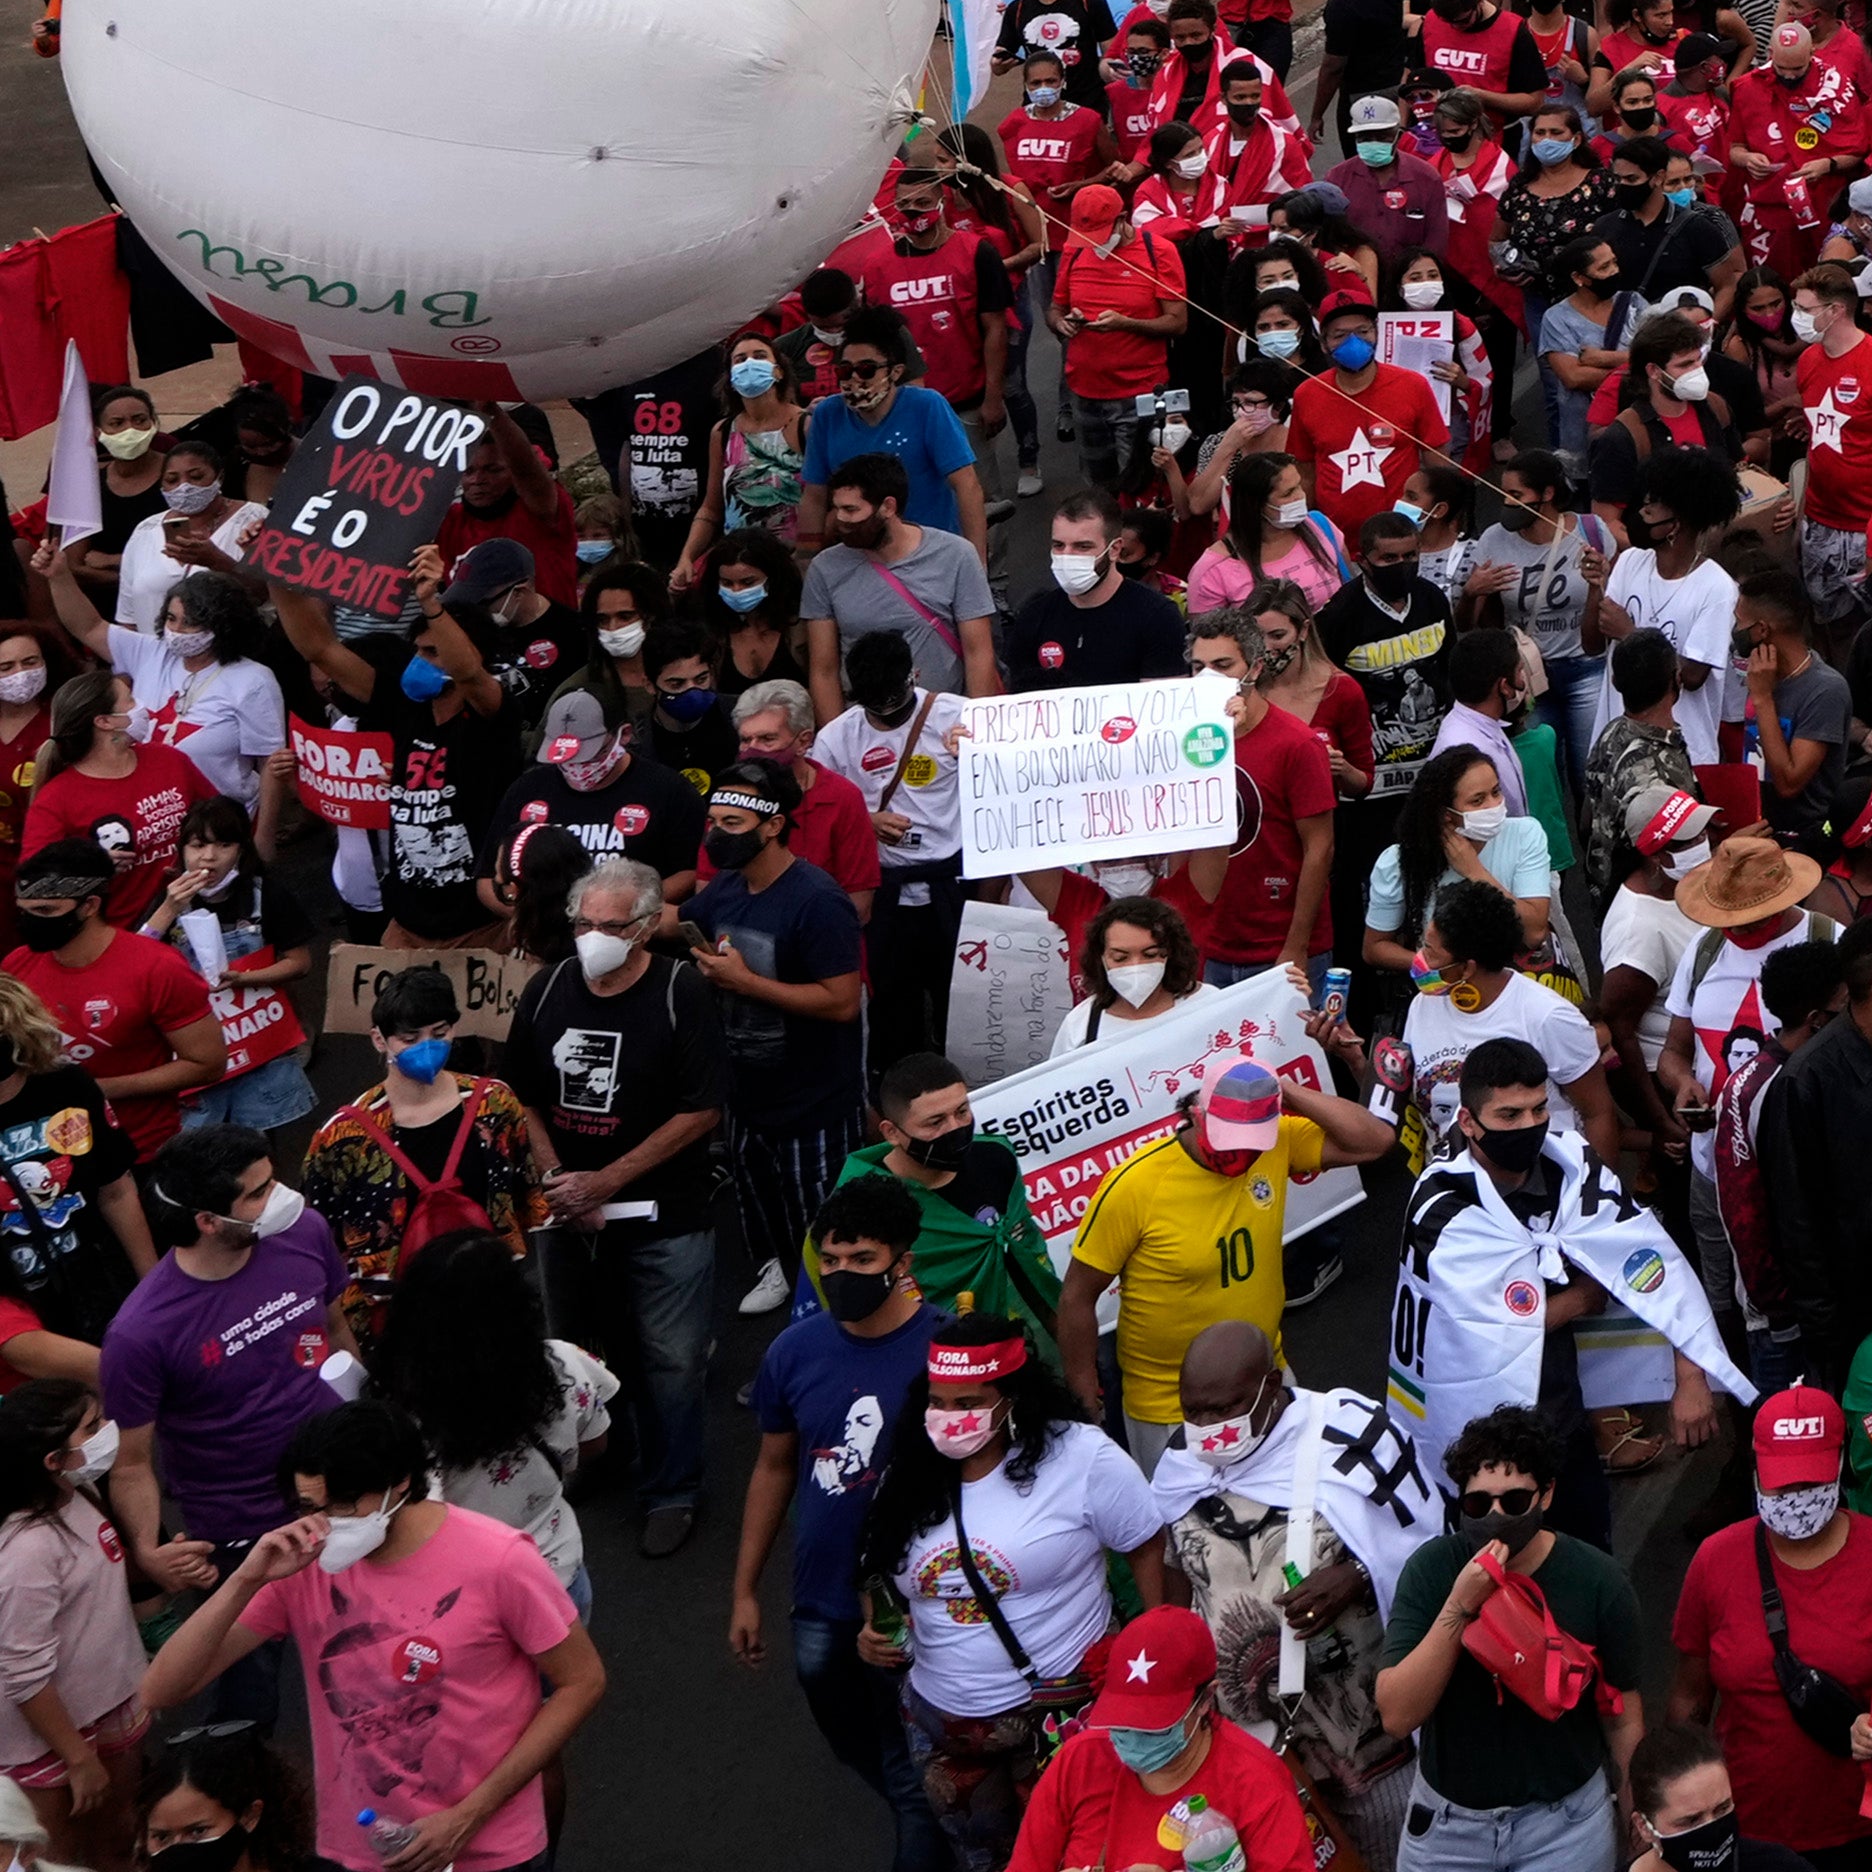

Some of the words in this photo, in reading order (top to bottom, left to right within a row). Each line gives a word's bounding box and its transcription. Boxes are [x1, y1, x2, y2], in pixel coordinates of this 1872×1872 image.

[1435, 49, 1482, 71] CUT
[1018, 138, 1066, 159] CUT
[889, 278, 946, 303] CUT
[331, 384, 374, 441] O
[378, 393, 487, 474] PIOR
[633, 400, 682, 435] 68
[1813, 413, 1838, 435] PT
[629, 432, 690, 452] sempre
[327, 444, 436, 517] VÍRUS
[1348, 451, 1377, 476] PT
[290, 487, 324, 533] É
[331, 509, 368, 548] O
[1130, 685, 1199, 726] VOTA
[291, 736, 384, 782] FORA
[971, 755, 1007, 801] EM
[1013, 739, 1123, 793] BOLSONARO
[1133, 730, 1179, 776] NÃO
[974, 796, 1068, 854] CONHECE
[1079, 789, 1133, 838] JESUS
[1141, 776, 1223, 830] CRISTO
[982, 1074, 1115, 1140] Espíritas
[1063, 1158, 1103, 1190] DA
[1217, 1227, 1256, 1290] 10
[218, 1319, 256, 1345] uma
[253, 1288, 299, 1333] cidade
[223, 1336, 246, 1358] de
[245, 1315, 282, 1349] todas
[278, 1294, 320, 1329] cores
[937, 1349, 970, 1368] FORA
[1772, 1415, 1824, 1439] CUT
